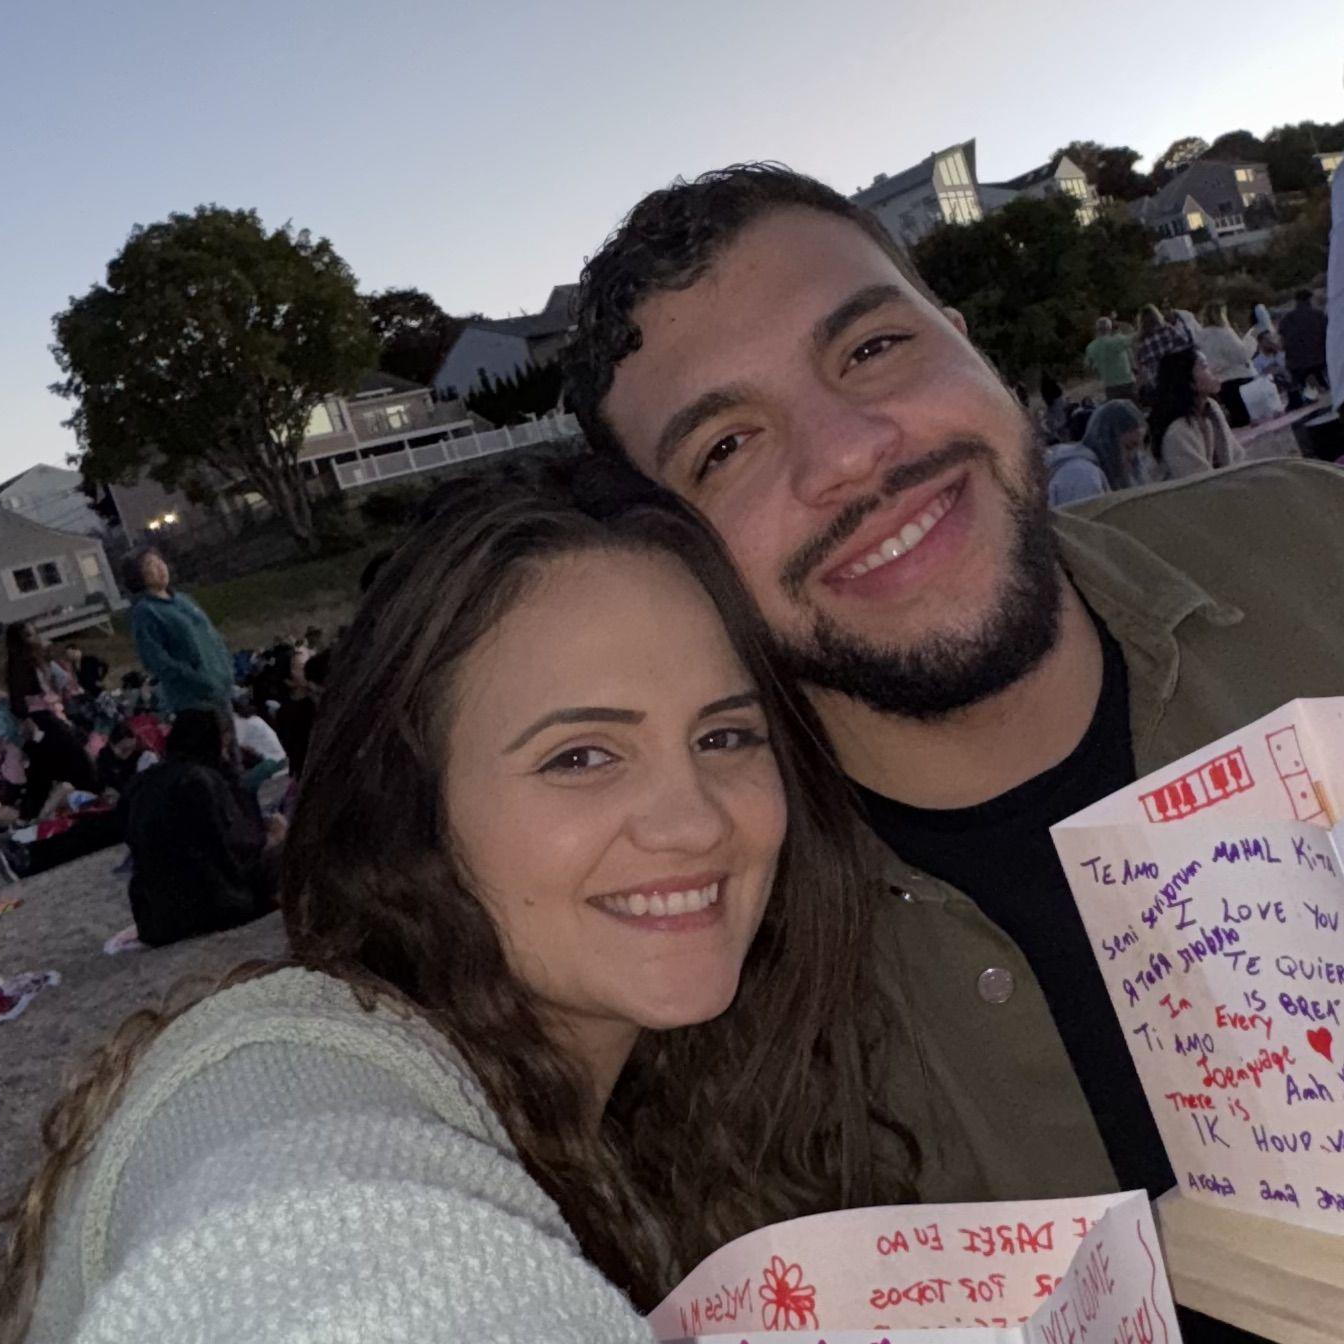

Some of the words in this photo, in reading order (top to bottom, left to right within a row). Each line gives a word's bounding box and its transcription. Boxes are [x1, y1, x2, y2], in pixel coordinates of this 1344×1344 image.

[1081, 856, 1116, 885] TE
[1121, 859, 1160, 886] AMO
[1167, 897, 1197, 930] I
[1222, 898, 1287, 923] LOVE
[1243, 990, 1267, 1012] IS
[1215, 1004, 1272, 1040] Every
[1174, 1032, 1215, 1058] AMO
[1191, 1113, 1231, 1148] IK
